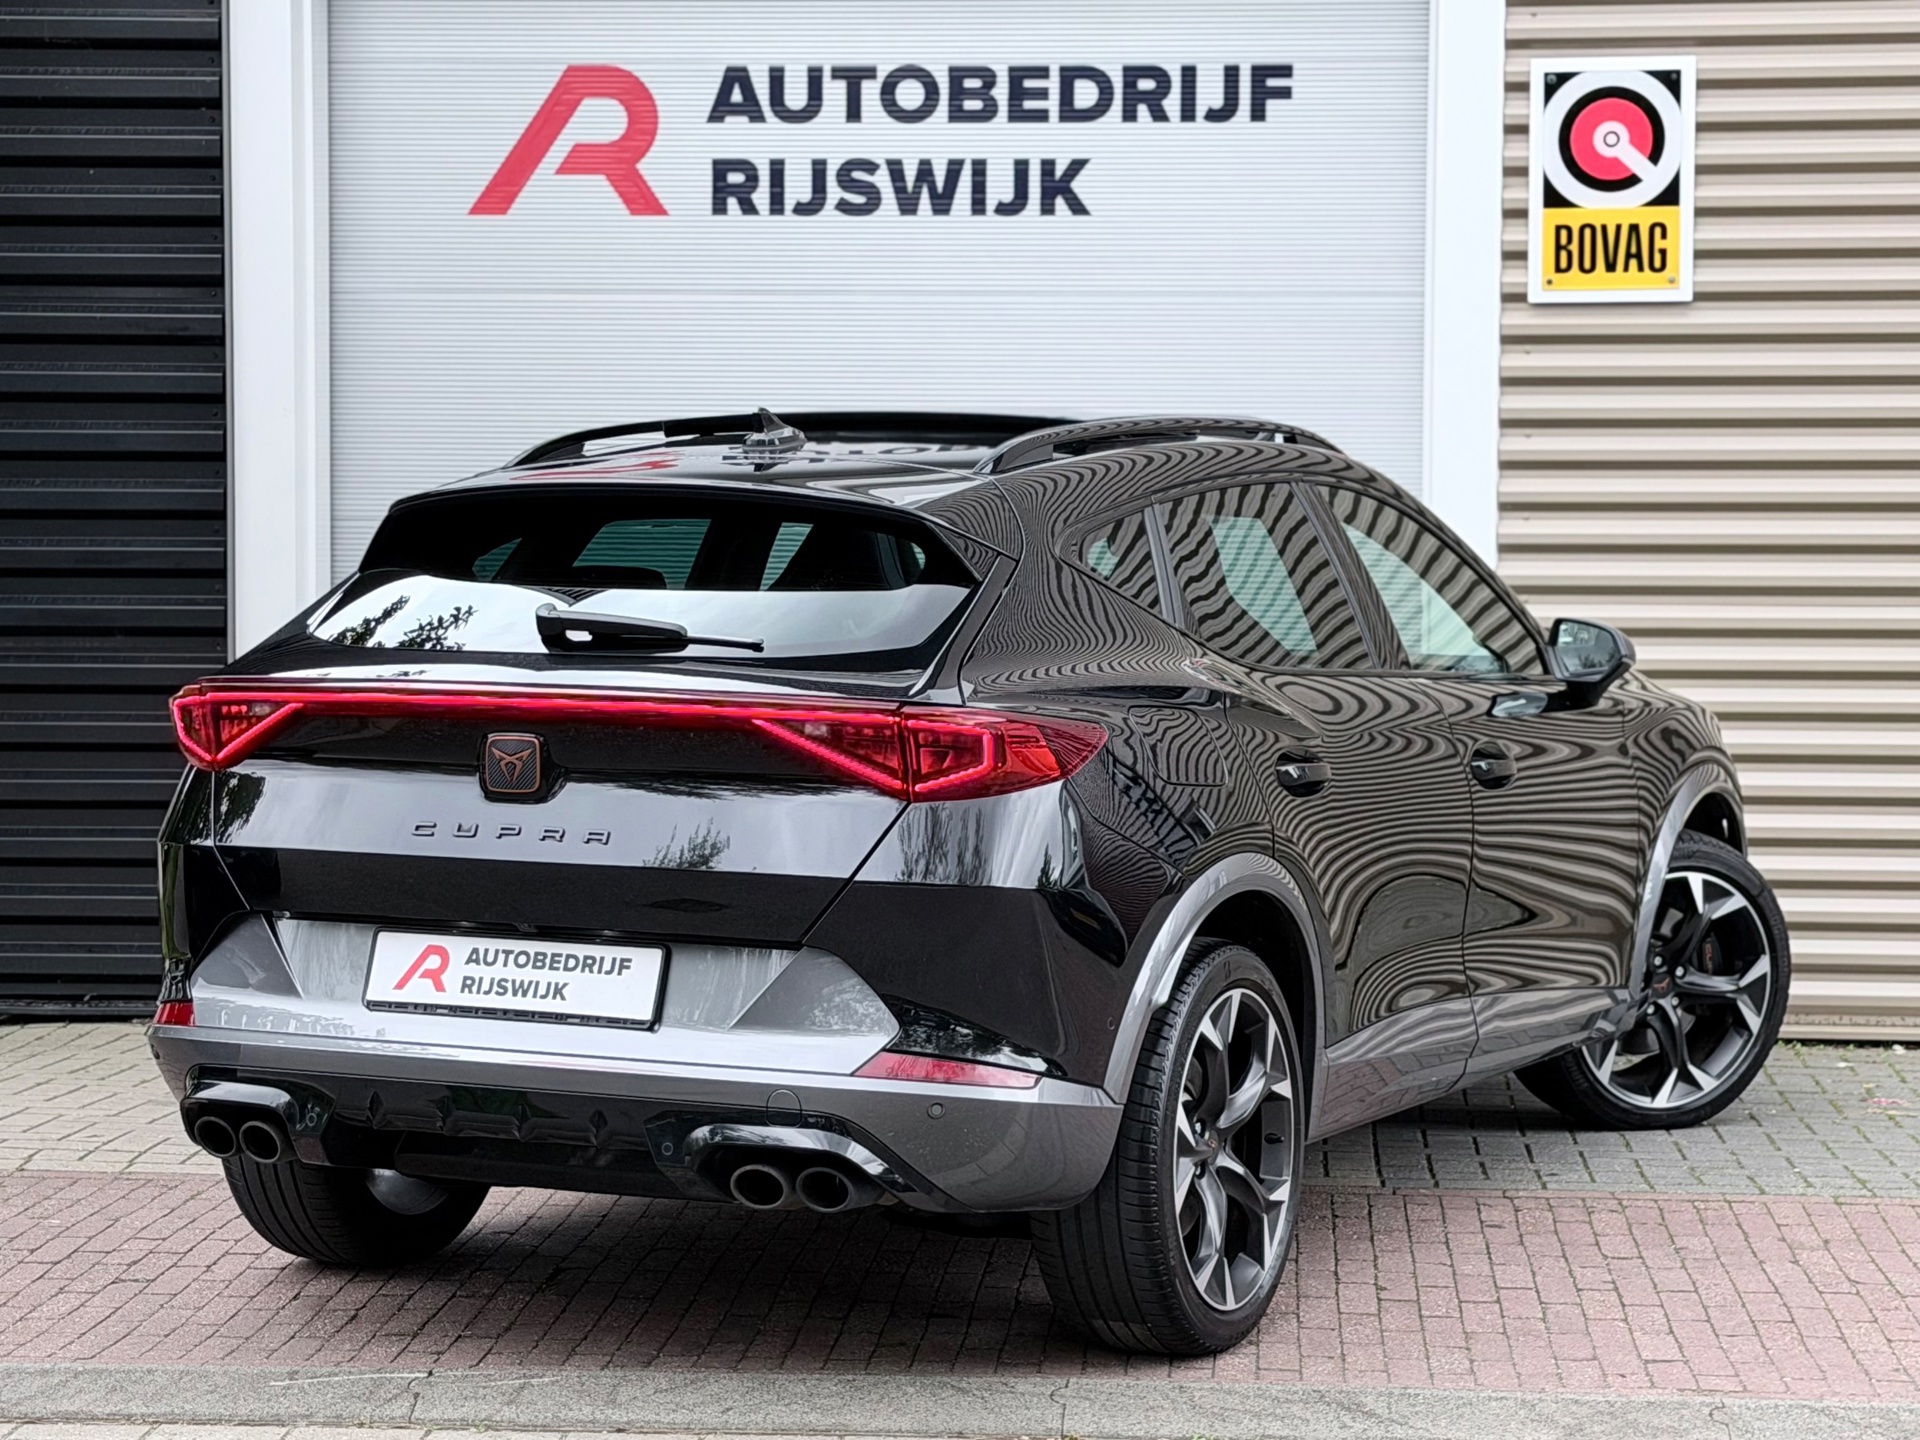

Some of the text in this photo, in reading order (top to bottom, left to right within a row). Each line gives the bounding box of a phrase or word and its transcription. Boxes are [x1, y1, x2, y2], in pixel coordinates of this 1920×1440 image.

[707, 64, 1293, 123] AUTOBEDRIJF
[711, 157, 1092, 216] RIJSWIJK
[1554, 222, 1668, 274] BOVAG
[412, 821, 611, 845] CUPRA
[464, 947, 632, 976] AUTOBEDRIJF
[460, 975, 570, 1000] RIJSWIJK
